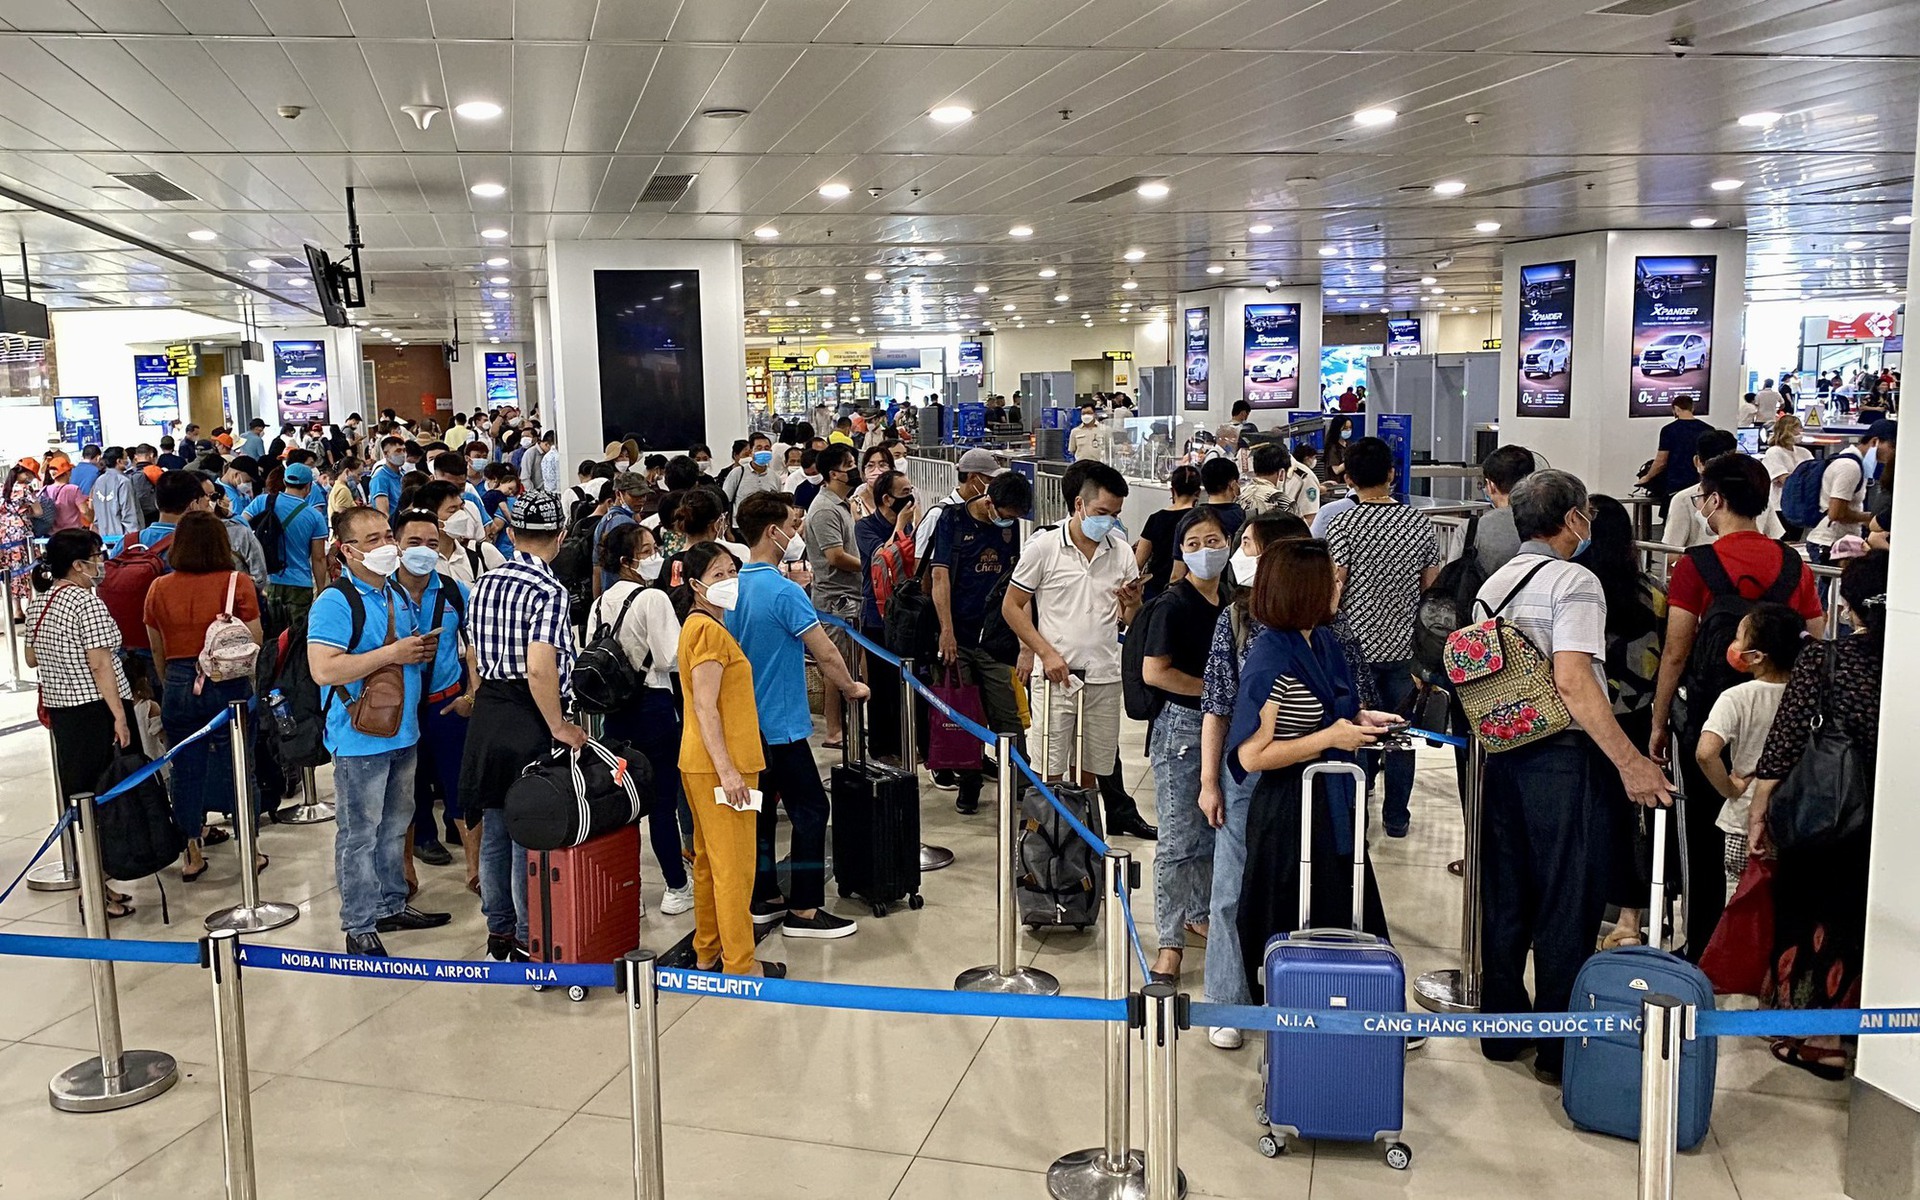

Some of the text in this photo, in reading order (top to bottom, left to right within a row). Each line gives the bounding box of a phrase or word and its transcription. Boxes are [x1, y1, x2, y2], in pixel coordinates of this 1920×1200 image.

[1529, 312, 1563, 321] XPANDER
[1650, 306, 1699, 316] XPANDER
[975, 562, 1002, 574] Chang
[281, 953, 490, 979] NOIBAI INTERNATIONAL AIRPORT
[525, 968, 558, 981] N.I.A
[687, 974, 764, 997] SECURITY
[1276, 1013, 1316, 1029] N.I.A
[1364, 1014, 1412, 1032] CẢNG
[1418, 1016, 1466, 1033] HÀNG
[1472, 1017, 1533, 1033] KHÔNG
[1538, 1014, 1588, 1034] QUỐC
[1594, 1014, 1615, 1032] TẾ
[1859, 1013, 1920, 1028] AN NIN
